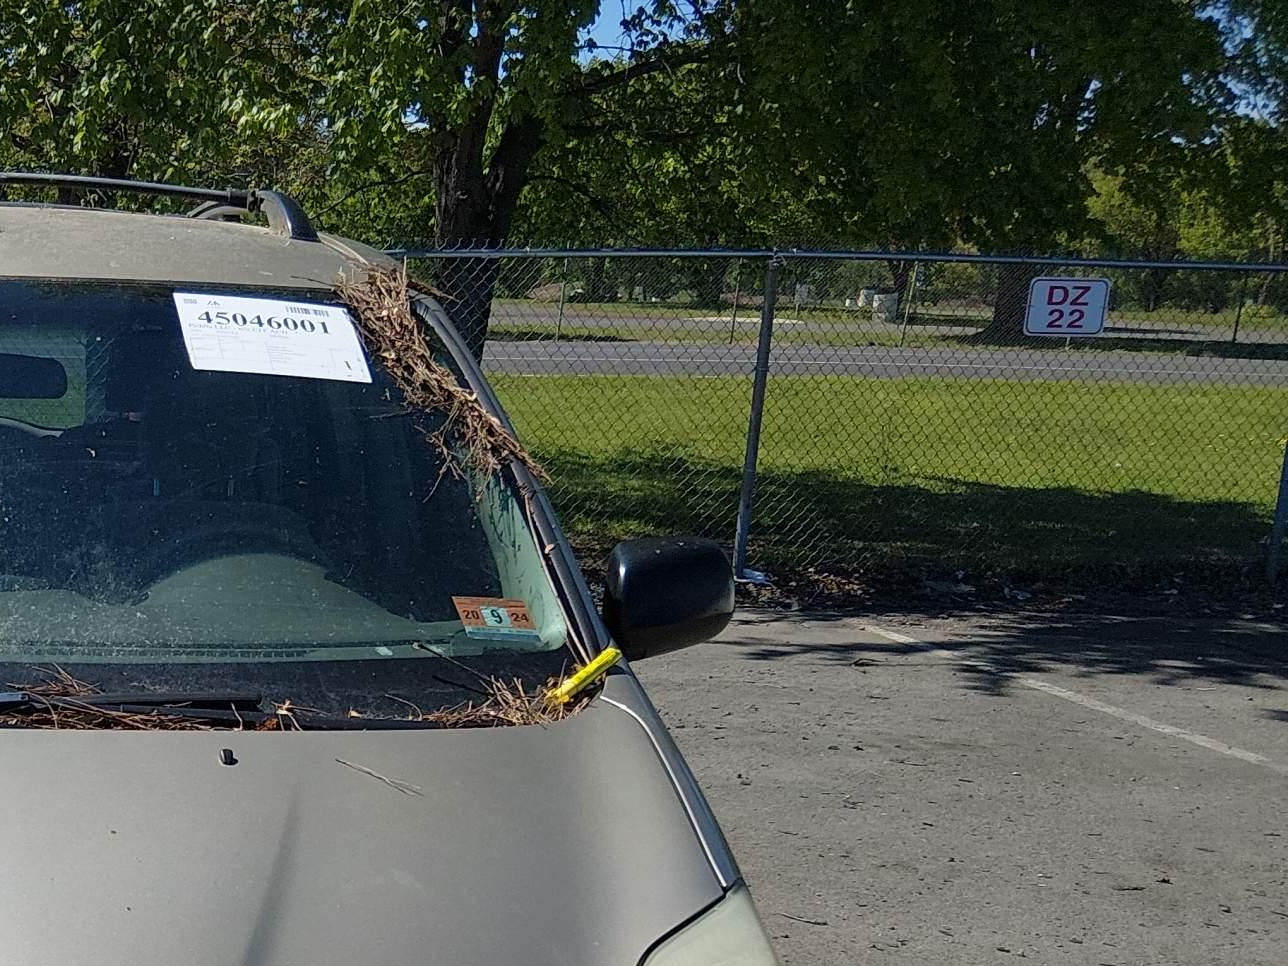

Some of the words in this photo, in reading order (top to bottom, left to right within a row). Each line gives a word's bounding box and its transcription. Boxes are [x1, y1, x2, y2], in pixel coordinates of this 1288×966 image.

[1047, 285, 1091, 306] DZ
[198, 311, 330, 334] 45046001
[1046, 308, 1085, 328] 22
[462, 609, 480, 620] 20
[490, 609, 503, 624] 9
[511, 612, 529, 623] 24
